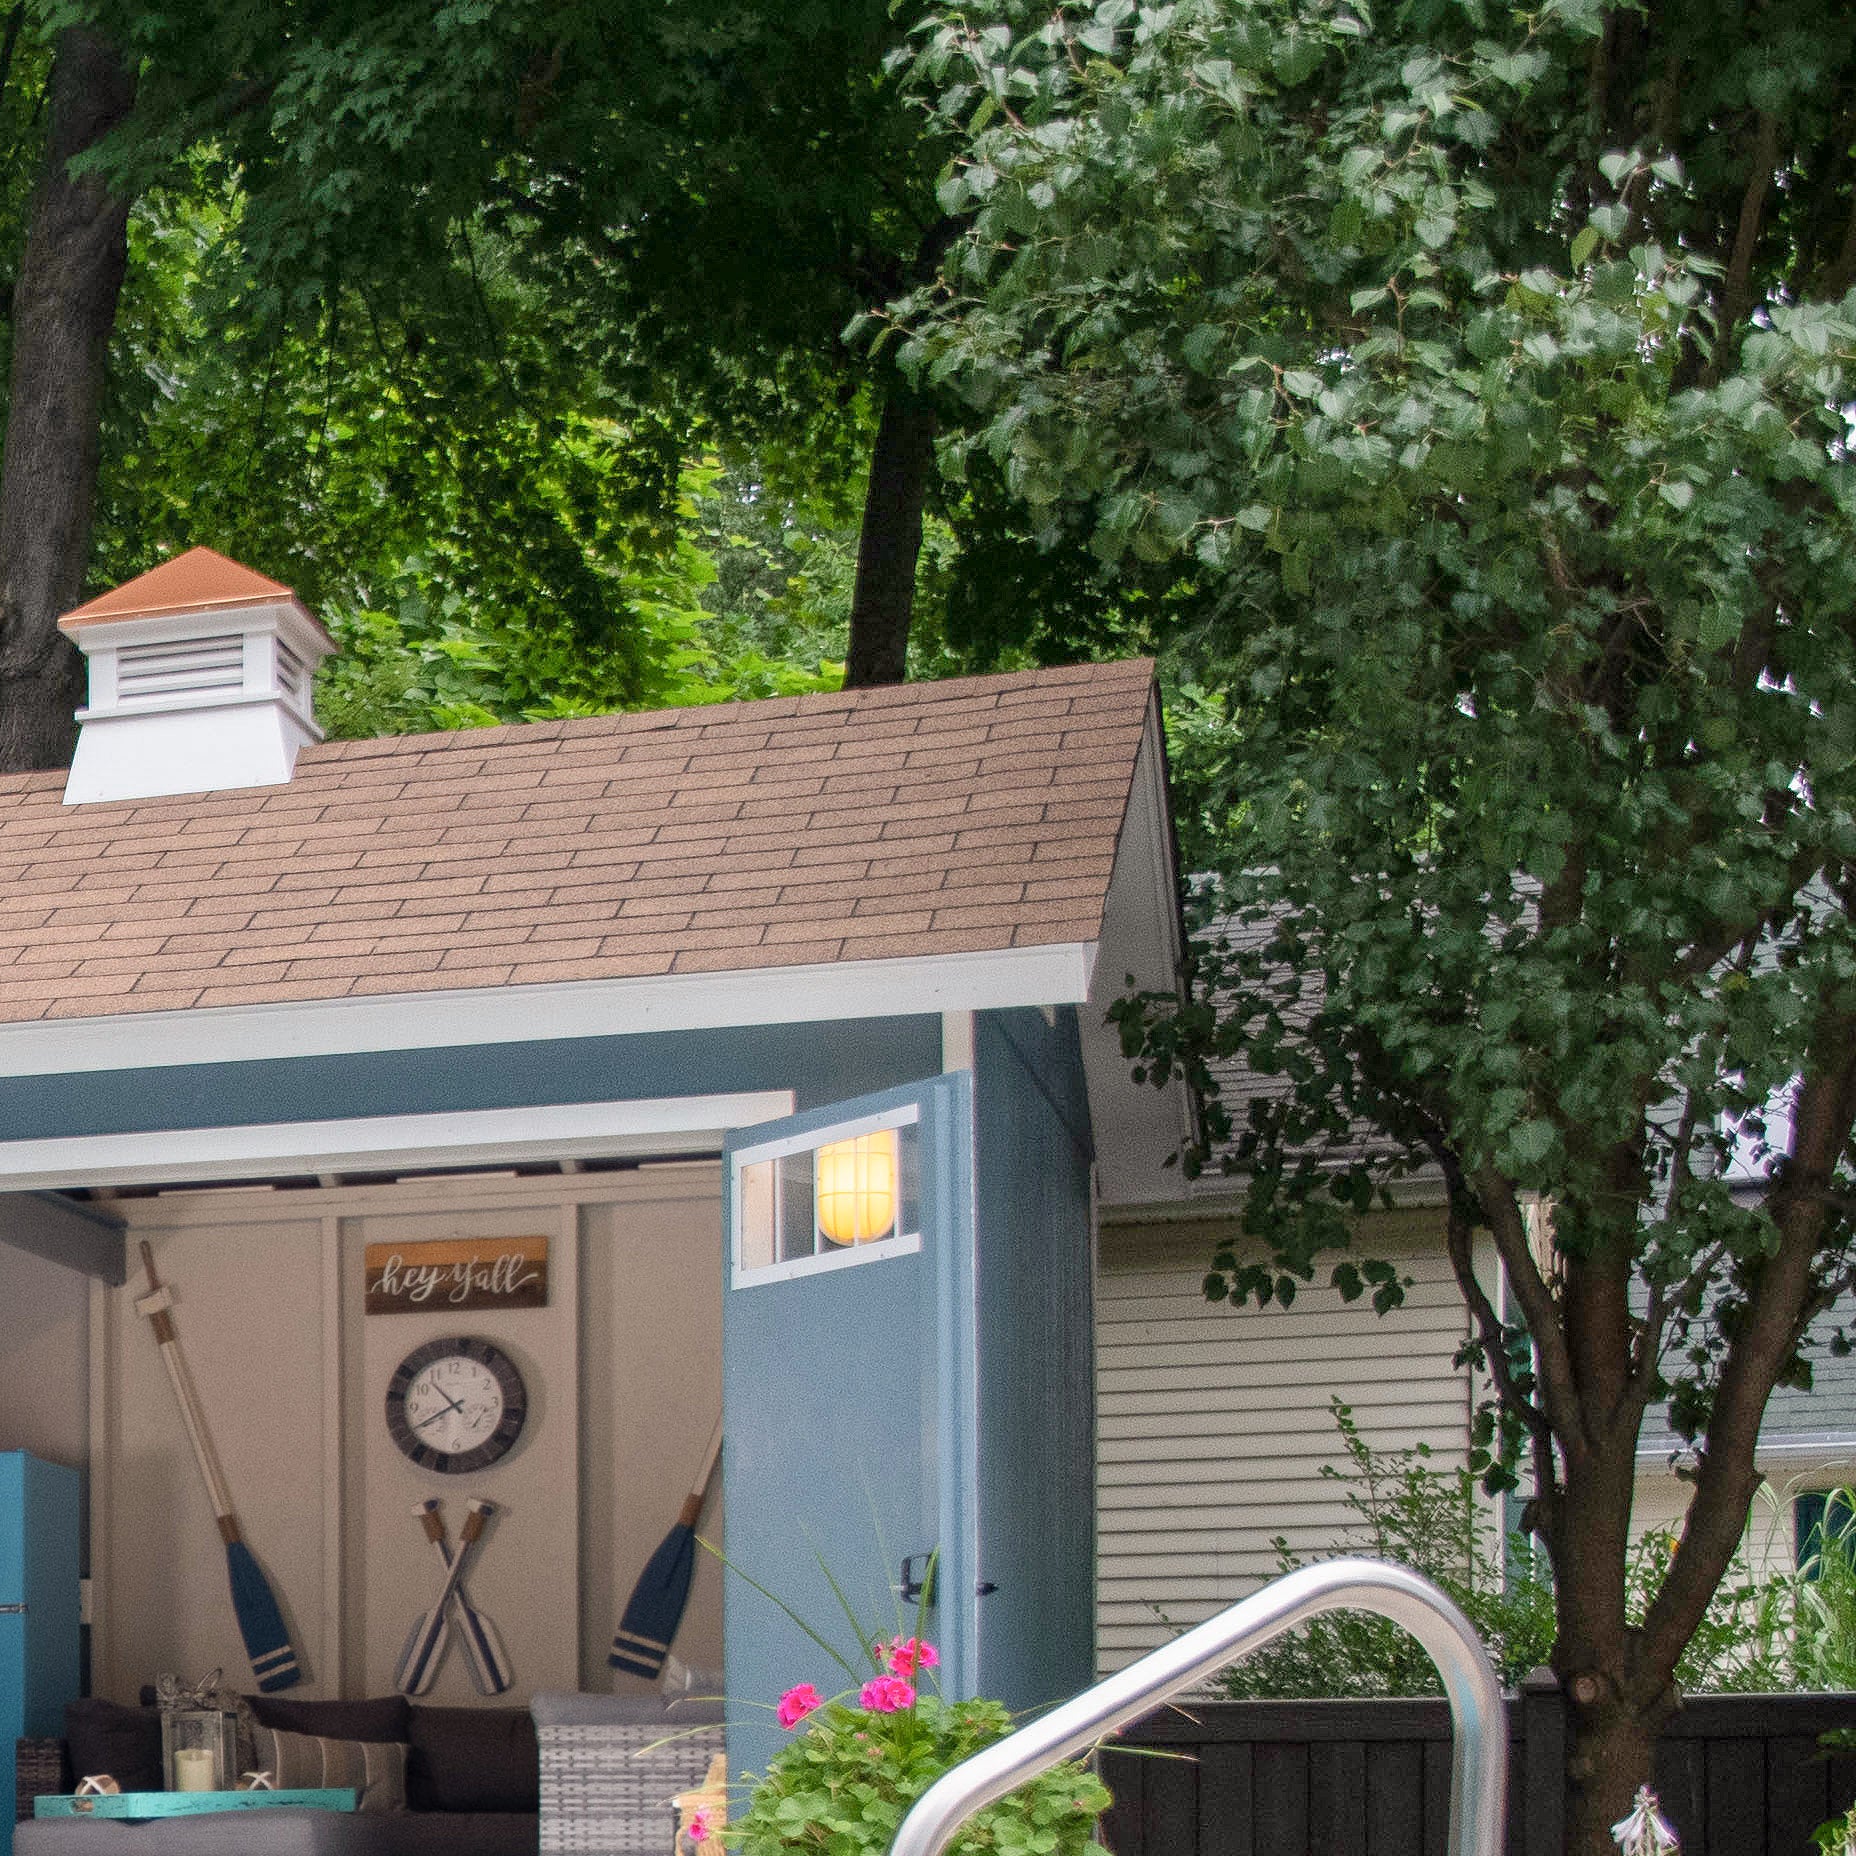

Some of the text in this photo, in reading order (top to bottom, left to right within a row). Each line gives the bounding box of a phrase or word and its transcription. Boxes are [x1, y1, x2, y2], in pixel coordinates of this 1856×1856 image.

[371, 1254, 446, 1302] hey
[430, 1368, 440, 1380] 11
[448, 1362, 460, 1374] 12
[417, 1383, 428, 1395] 10
[482, 1378, 490, 1390] 2
[492, 1396, 498, 1407] 3
[409, 1403, 418, 1413] 9
[451, 1438, 460, 1450] 6
